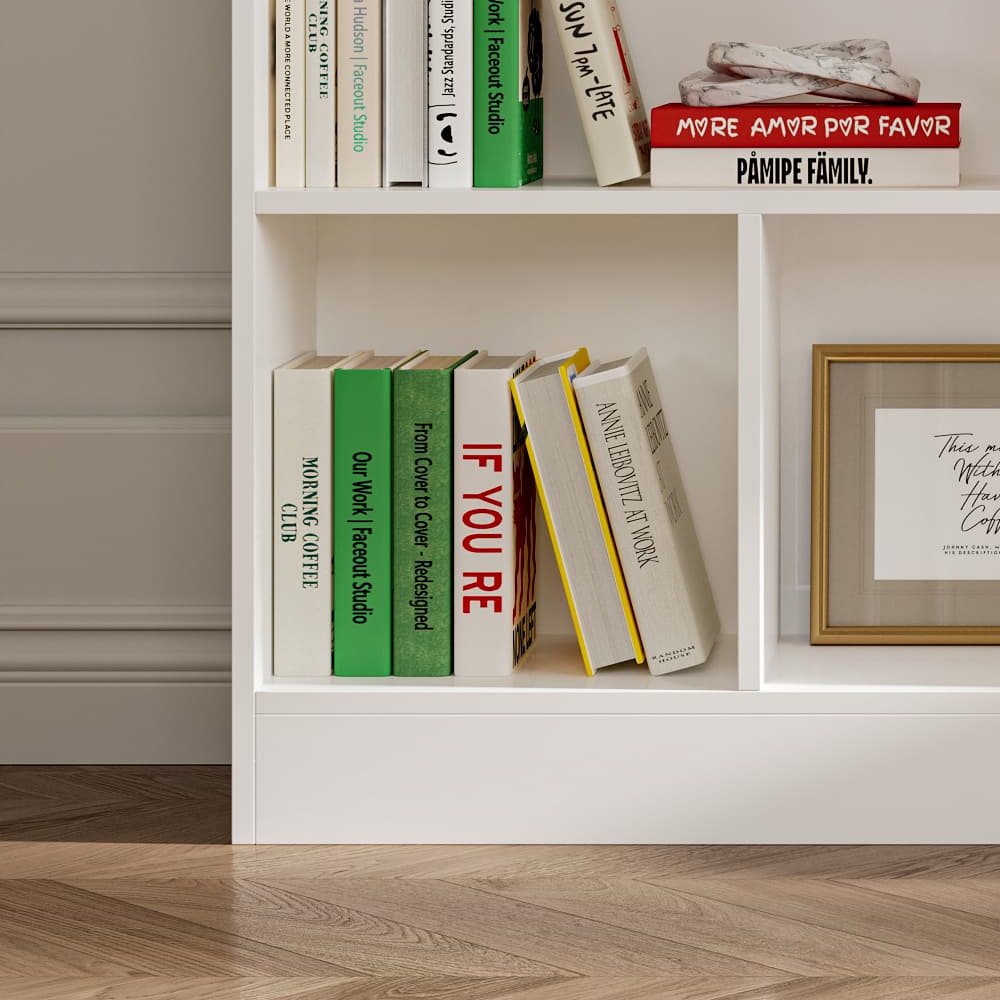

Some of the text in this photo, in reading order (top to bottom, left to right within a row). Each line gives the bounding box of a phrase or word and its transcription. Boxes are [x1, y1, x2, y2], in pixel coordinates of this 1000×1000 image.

[309, 14, 317, 52] CLUB
[353, 7, 368, 52] Hudson
[441, 27, 455, 74] Standards,
[488, 38, 504, 88] Faceout
[320, 44, 328, 99] COFFEE
[354, 65, 367, 110] Faceout
[442, 78, 455, 97] Jazz
[488, 93, 504, 134] Studio
[677, 115, 950, 138] MORE AMOR POR FAVOR
[354, 115, 368, 152] Studio
[738, 151, 872, 184] PÅMIPE FÄMILY.
[414, 423, 432, 453] From
[934, 433, 979, 458] This
[352, 452, 372, 477] Our
[415, 458, 432, 493] Cover
[352, 480, 373, 515] Work
[415, 496, 431, 508] to
[595, 402, 659, 569] ANNIE LEIBOVITZ AT WORK
[281, 504, 297, 542] CLUB
[303, 458, 319, 588] MORNING COFFEE
[414, 513, 432, 548] Cover
[463, 444, 502, 613] IF YOU RE
[352, 528, 372, 578] Faceout
[352, 582, 373, 624] Studio
[409, 561, 434, 631] Redesigned
